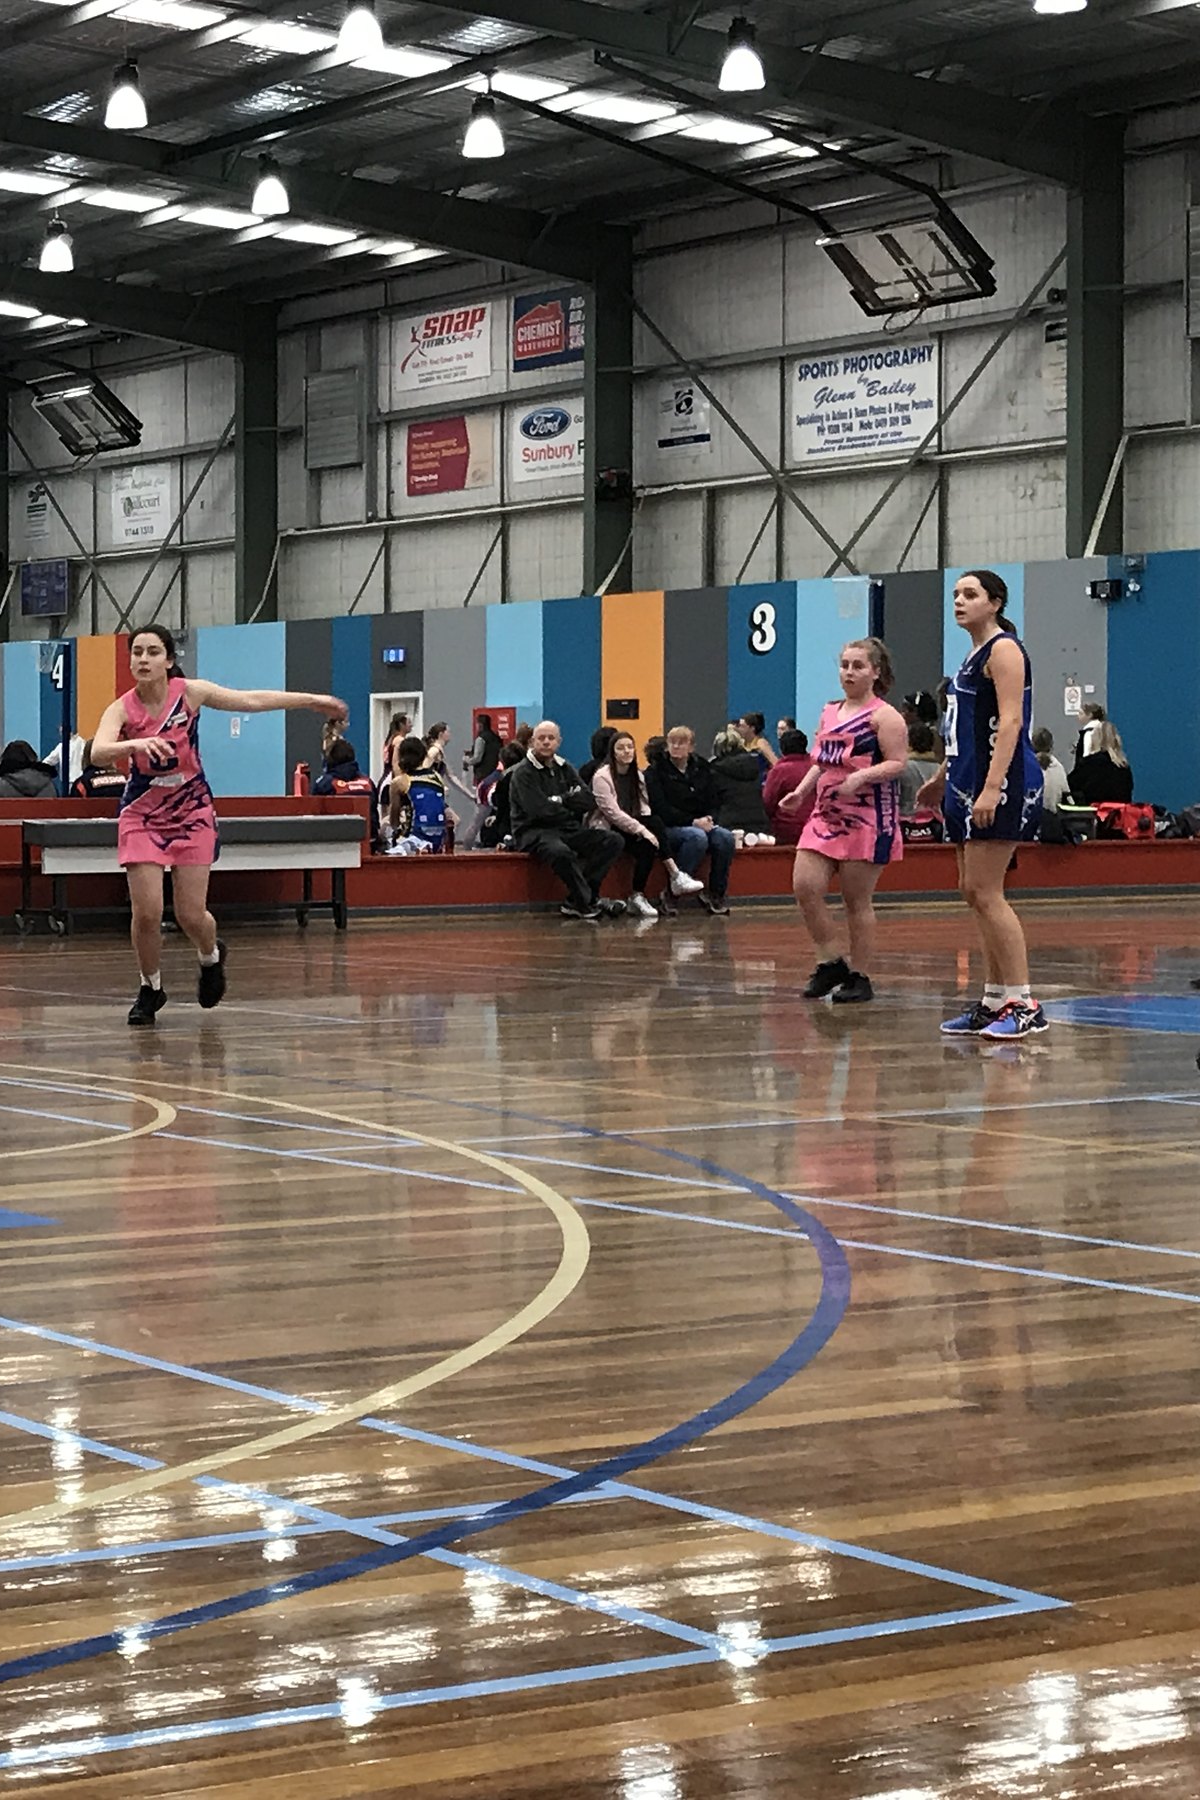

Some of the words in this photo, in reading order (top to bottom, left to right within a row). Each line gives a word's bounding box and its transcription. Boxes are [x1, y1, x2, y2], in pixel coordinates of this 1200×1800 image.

[517, 320, 561, 343] CHEMIST
[517, 337, 560, 352] WAREHOUSE
[798, 360, 839, 381] SPORTS
[843, 344, 934, 375] PHOTOGRAPHY
[857, 373, 869, 385] by
[814, 386, 856, 409] Glenn
[866, 379, 917, 397] Bailey
[530, 413, 561, 435] Ford
[522, 444, 575, 463] Sunbury
[751, 602, 776, 652] 3
[51, 654, 63, 689] 4
